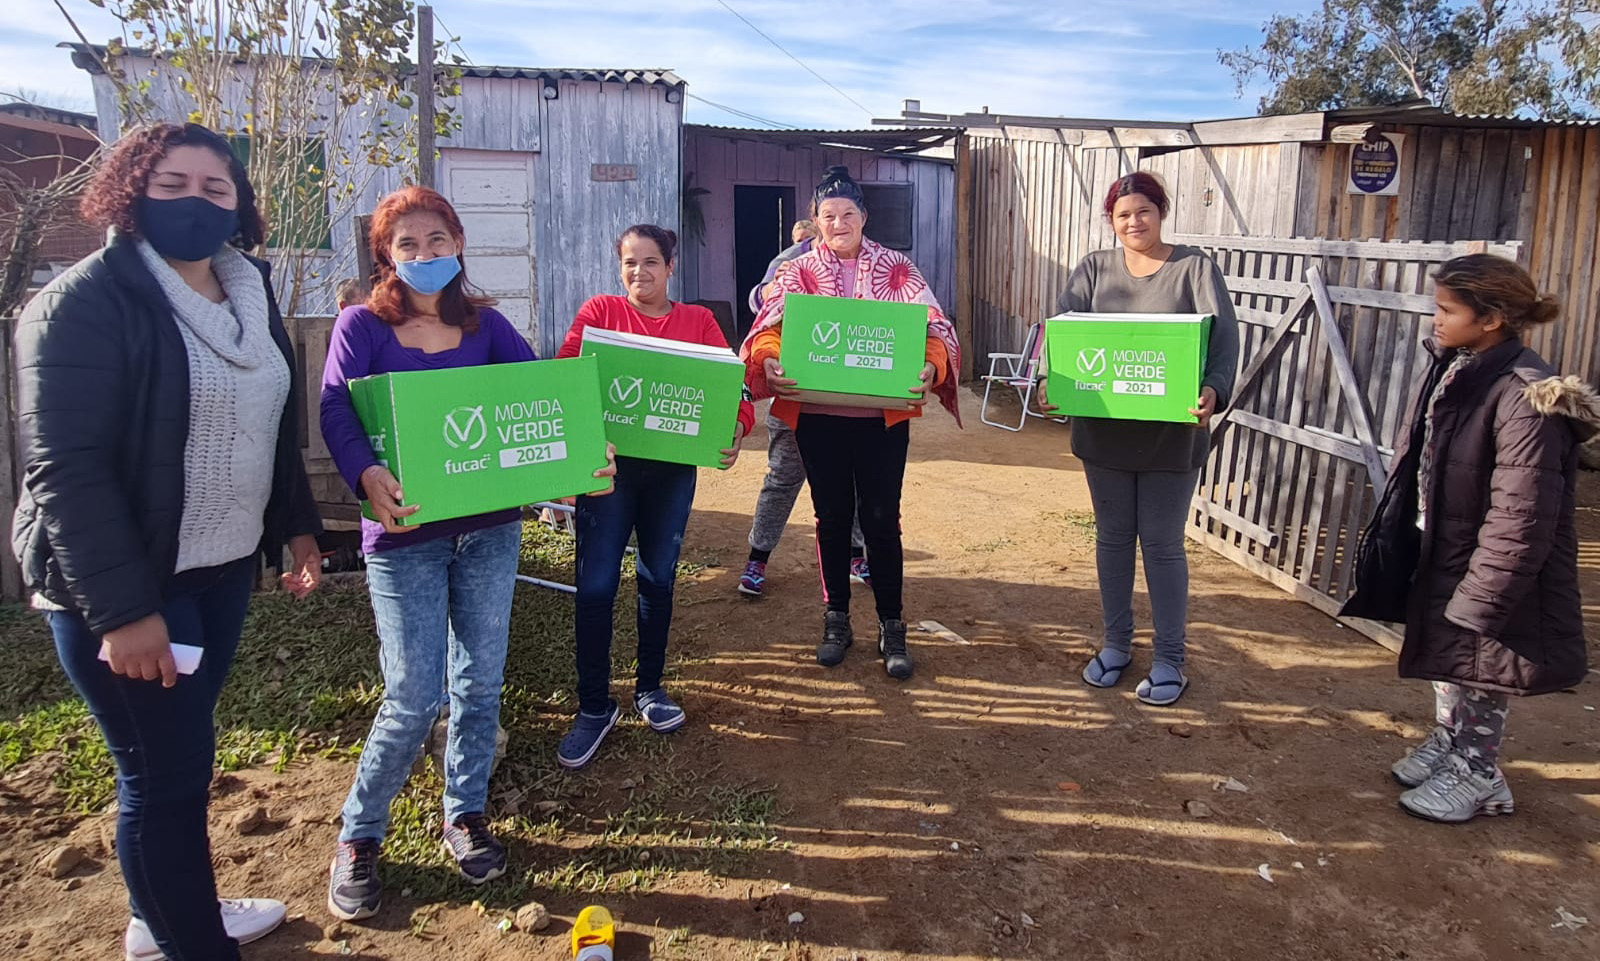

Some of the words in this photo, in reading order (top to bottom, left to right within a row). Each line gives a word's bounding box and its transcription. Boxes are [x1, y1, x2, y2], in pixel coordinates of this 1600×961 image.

[1361, 140, 1390, 152] CHIP
[846, 324, 896, 340] MOVIDA
[847, 338, 895, 355] VERDE
[856, 356, 881, 368] 2021
[1112, 349, 1166, 363] MOVIDA
[1113, 364, 1166, 379] VERDE
[649, 381, 705, 402] MOVIDA
[1125, 382, 1152, 393] 2021
[495, 398, 563, 422] MOVIDA
[649, 397, 704, 419] VERDE
[496, 418, 565, 444] VERDE
[657, 418, 687, 433] 2021
[516, 445, 552, 463] 2021
